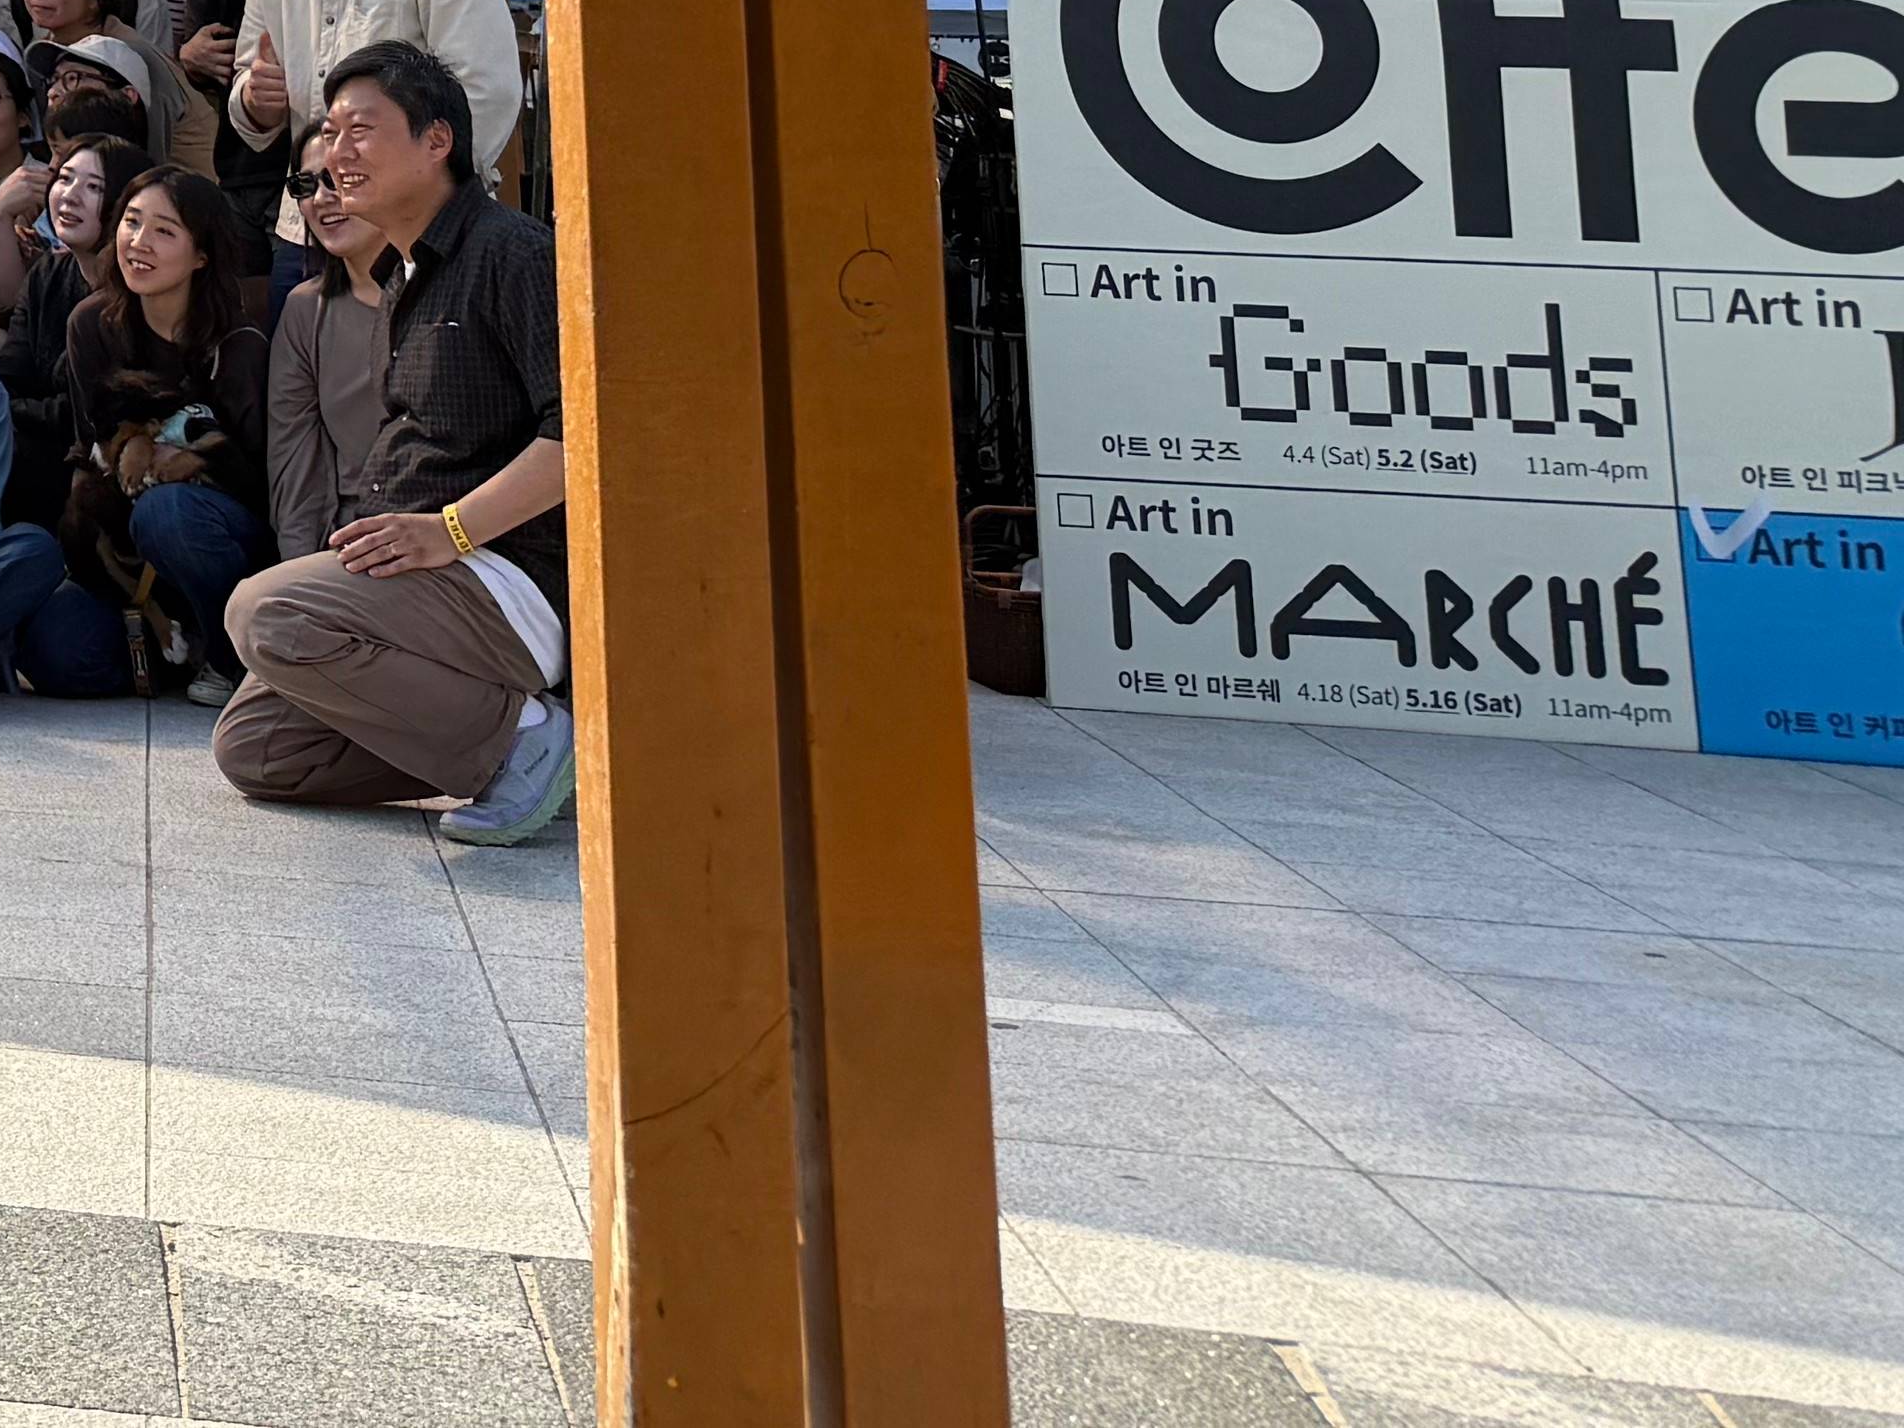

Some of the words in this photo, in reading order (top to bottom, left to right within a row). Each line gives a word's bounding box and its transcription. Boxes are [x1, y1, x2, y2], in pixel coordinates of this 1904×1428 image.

[1091, 263, 1161, 301] Art
[1174, 264, 1216, 302] in
[1726, 288, 1802, 326] Art
[1816, 288, 1861, 328] in
[1208, 302, 1638, 438] Goods
[1101, 434, 1151, 458] 아트
[1159, 436, 1182, 461] 인
[1192, 438, 1242, 463] 굿즈
[1283, 445, 1315, 464] 4.4
[1321, 446, 1371, 470] (Sat)
[1376, 448, 1414, 468] 5.2
[1421, 449, 1477, 476] (Sat)
[1527, 457, 1648, 482] 11am-4pm
[1741, 465, 1795, 489] 아트
[1802, 467, 1828, 491] 인
[1106, 495, 1178, 534] Art
[1190, 496, 1233, 537] in
[1748, 528, 1827, 569] Art
[1838, 529, 1886, 572] in
[1109, 550, 1670, 687] MARCHÉ
[1118, 669, 1168, 694] 아트
[1175, 672, 1198, 697] 인
[1207, 674, 1281, 703] 마르쉐
[1297, 683, 1344, 703] 4.18
[1349, 684, 1400, 710] (Sat)
[1405, 688, 1458, 710] 5.16
[1464, 691, 1523, 718] (Sat)
[1548, 697, 1672, 727] 11am-4pm
[1764, 709, 1820, 735] 아트
[1827, 712, 1855, 739] 인
